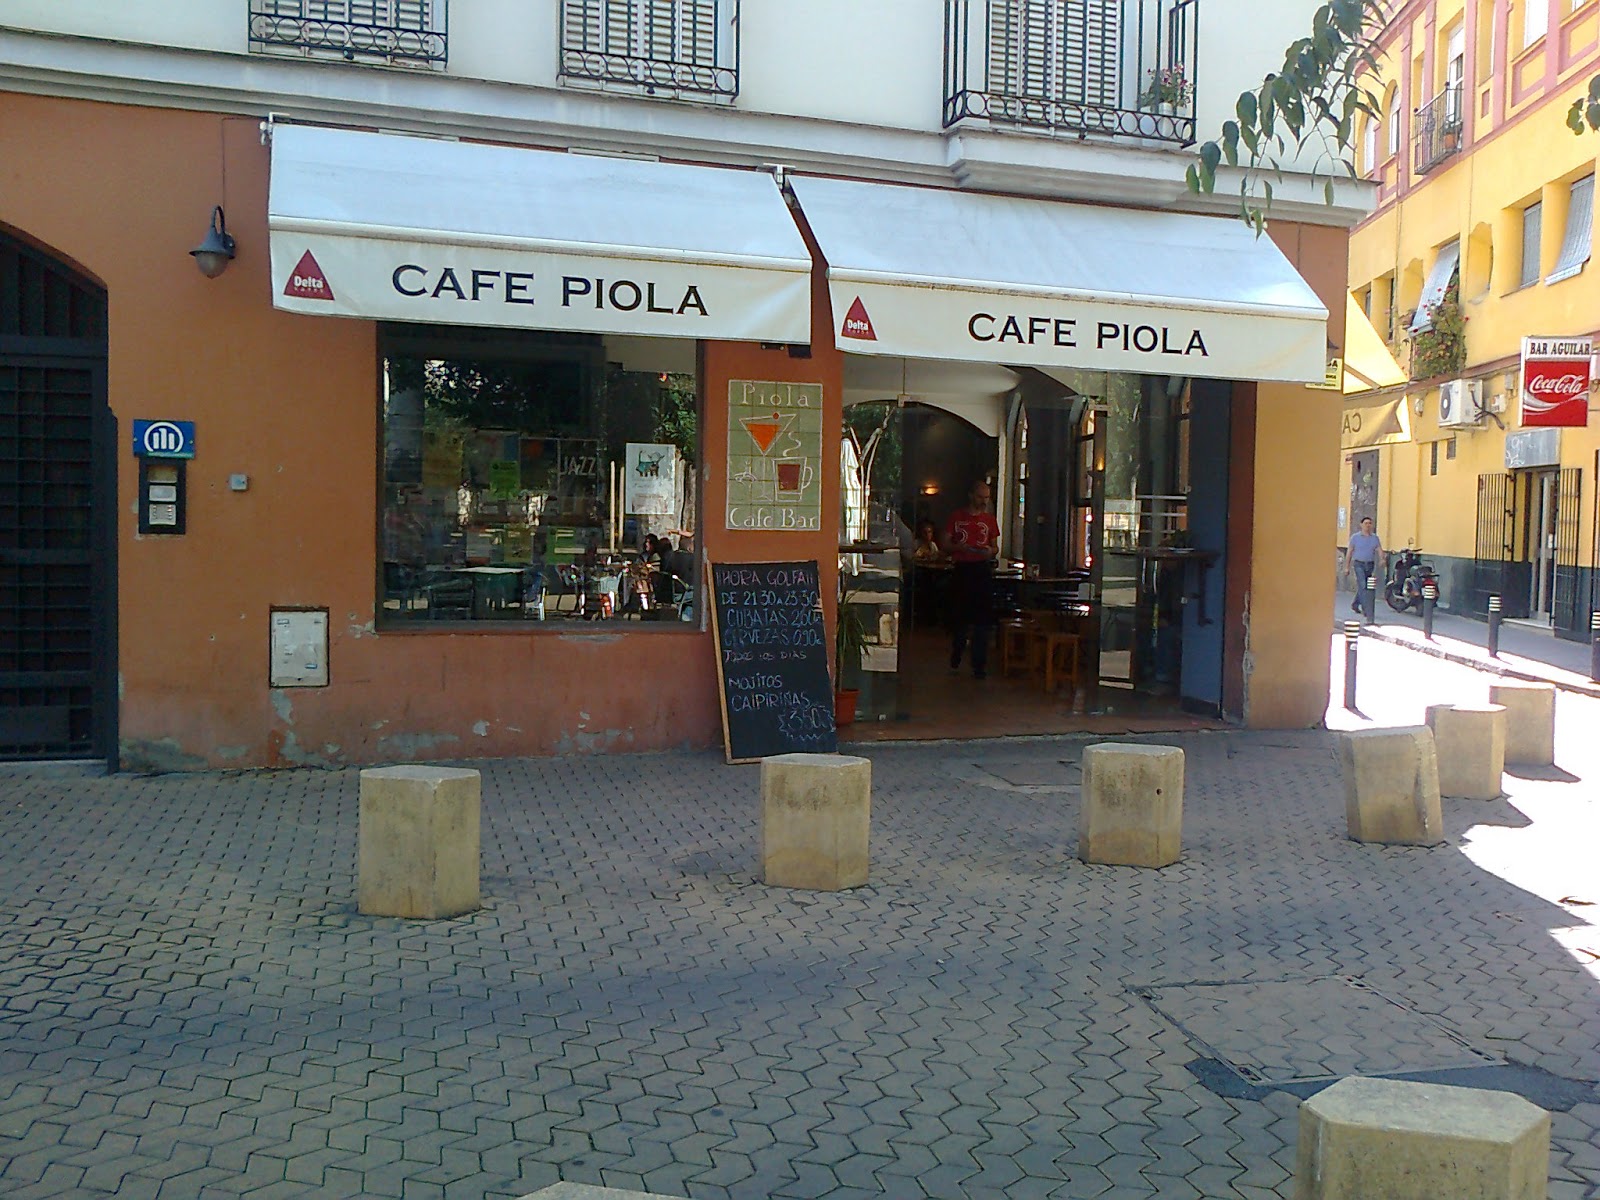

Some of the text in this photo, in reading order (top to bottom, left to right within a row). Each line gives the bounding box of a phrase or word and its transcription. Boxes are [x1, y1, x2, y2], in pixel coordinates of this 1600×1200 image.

[294, 275, 324, 288] Delta
[392, 264, 710, 317] CAFE PIOLA
[847, 319, 869, 331] Delta
[967, 312, 1210, 357] CAFE PIOLA
[1530, 342, 1591, 355] BAR AGUILAR
[741, 382, 809, 407] Piola
[559, 456, 597, 476] JAZZ
[729, 507, 817, 528] Cafe Bar
[727, 608, 789, 629] CUBATAS
